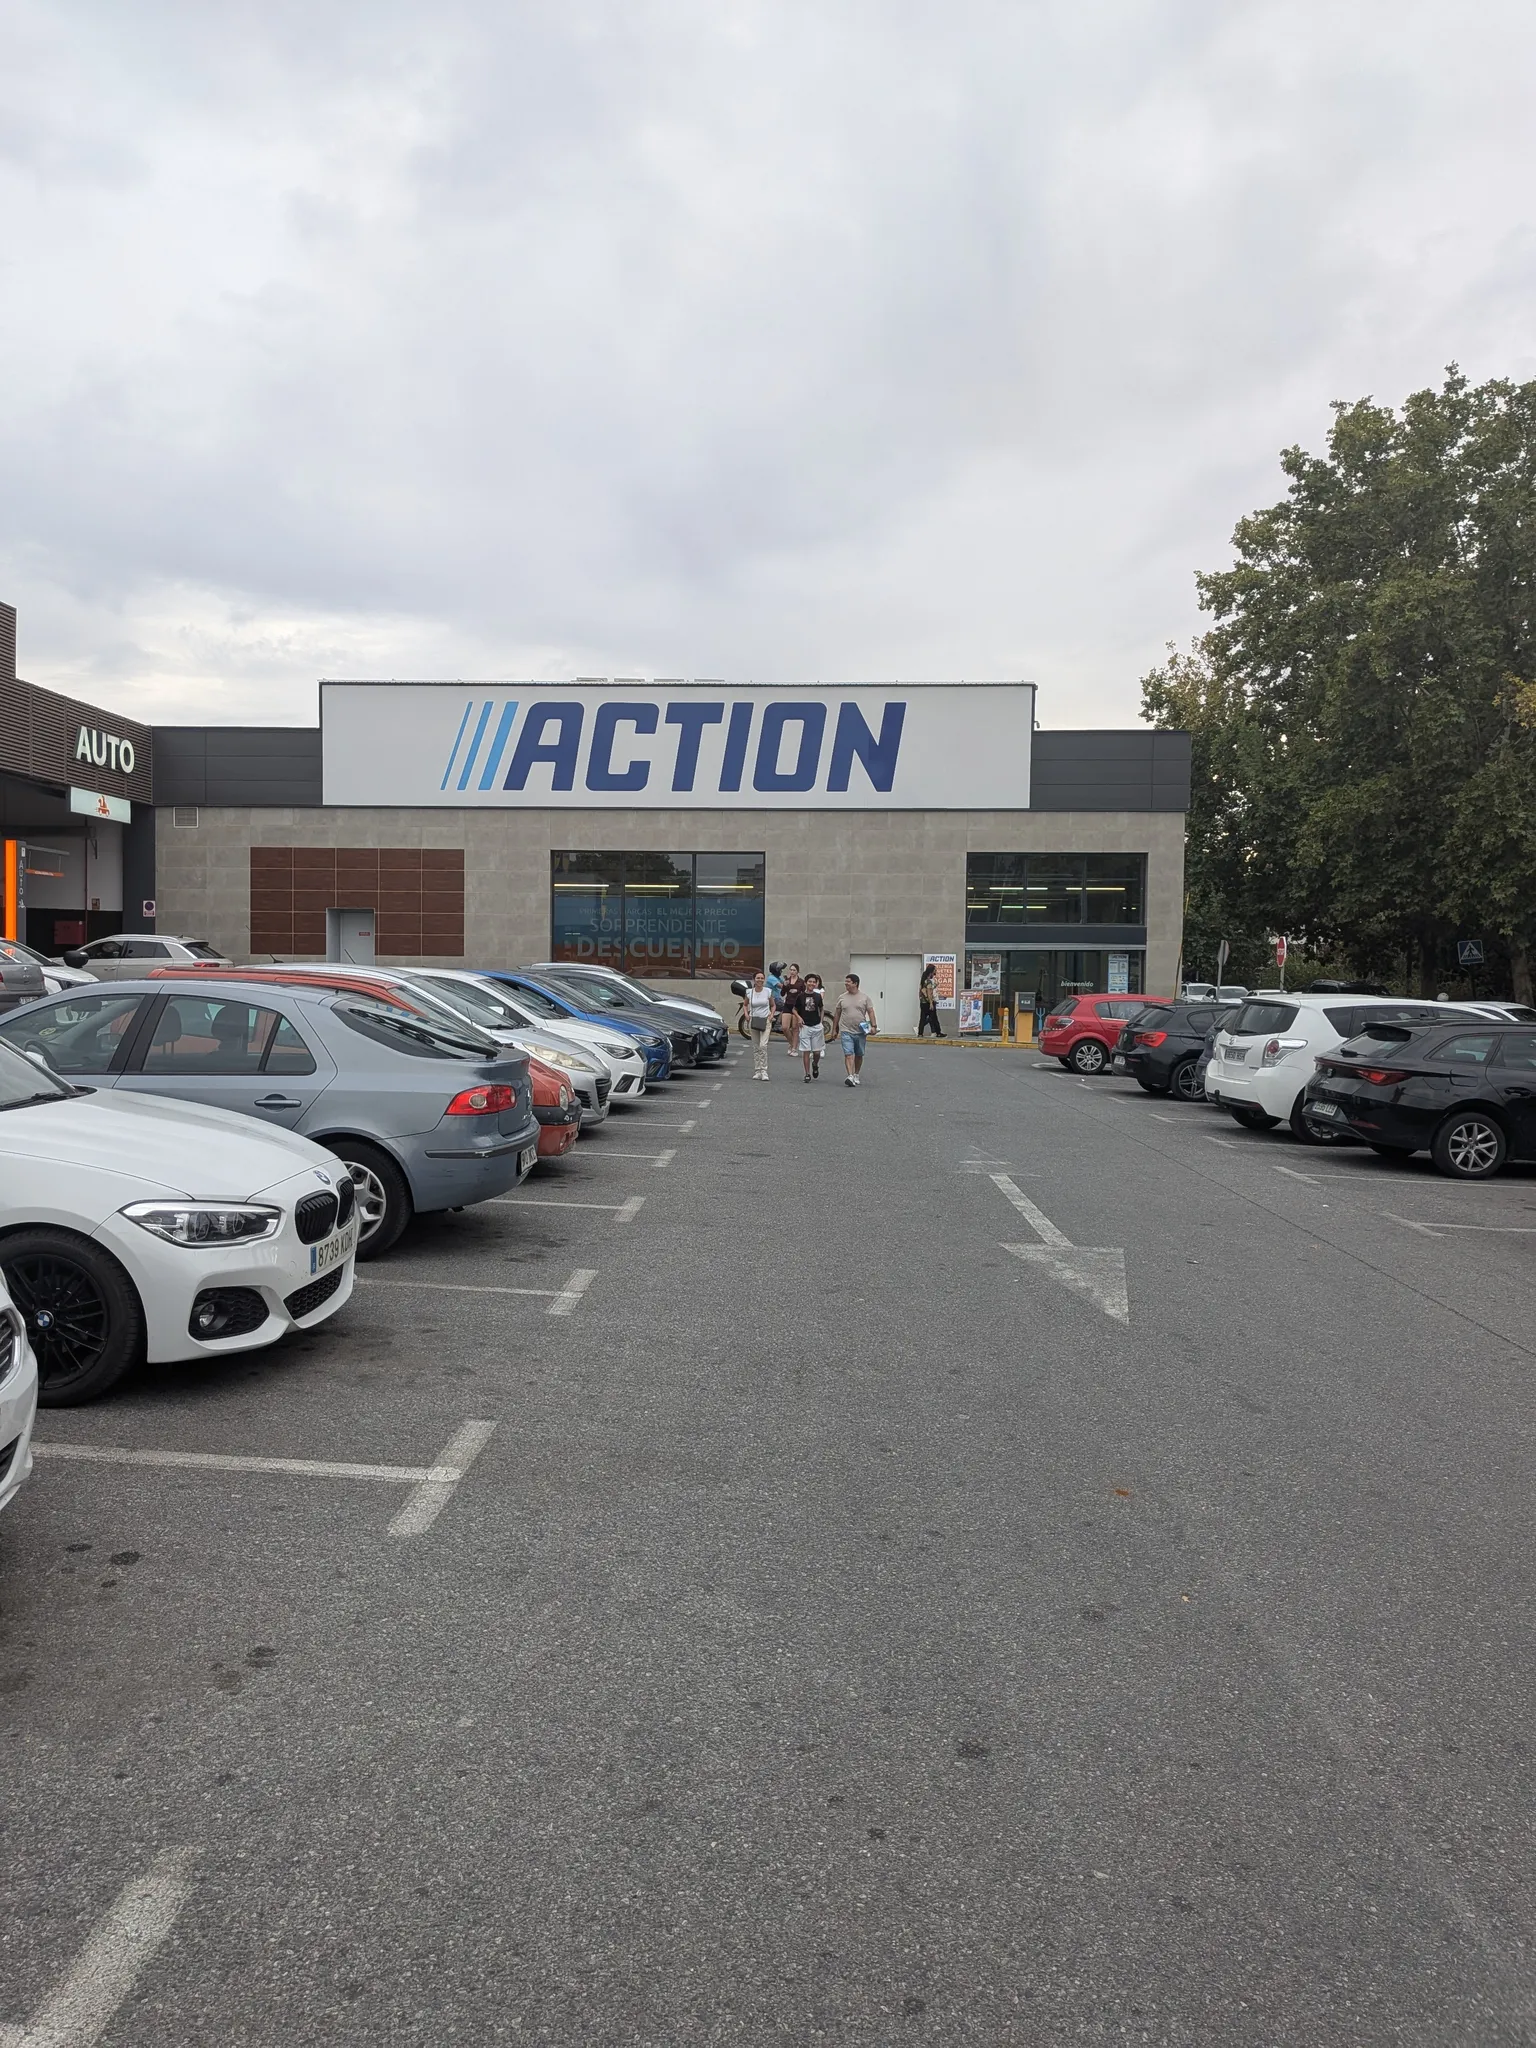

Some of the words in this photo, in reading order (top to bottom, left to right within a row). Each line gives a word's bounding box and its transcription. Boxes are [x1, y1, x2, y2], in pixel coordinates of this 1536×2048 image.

[75, 725, 135, 774] AUTO
[503, 702, 906, 792] ACTION
[656, 908, 668, 916] EL
[704, 908, 738, 916] PRECIO
[590, 918, 727, 933] SORPRENDENTE
[577, 936, 740, 959] DESCUENTO
[1060, 980, 1094, 988] bienvenido
[319, 1238, 339, 1267] 8739
